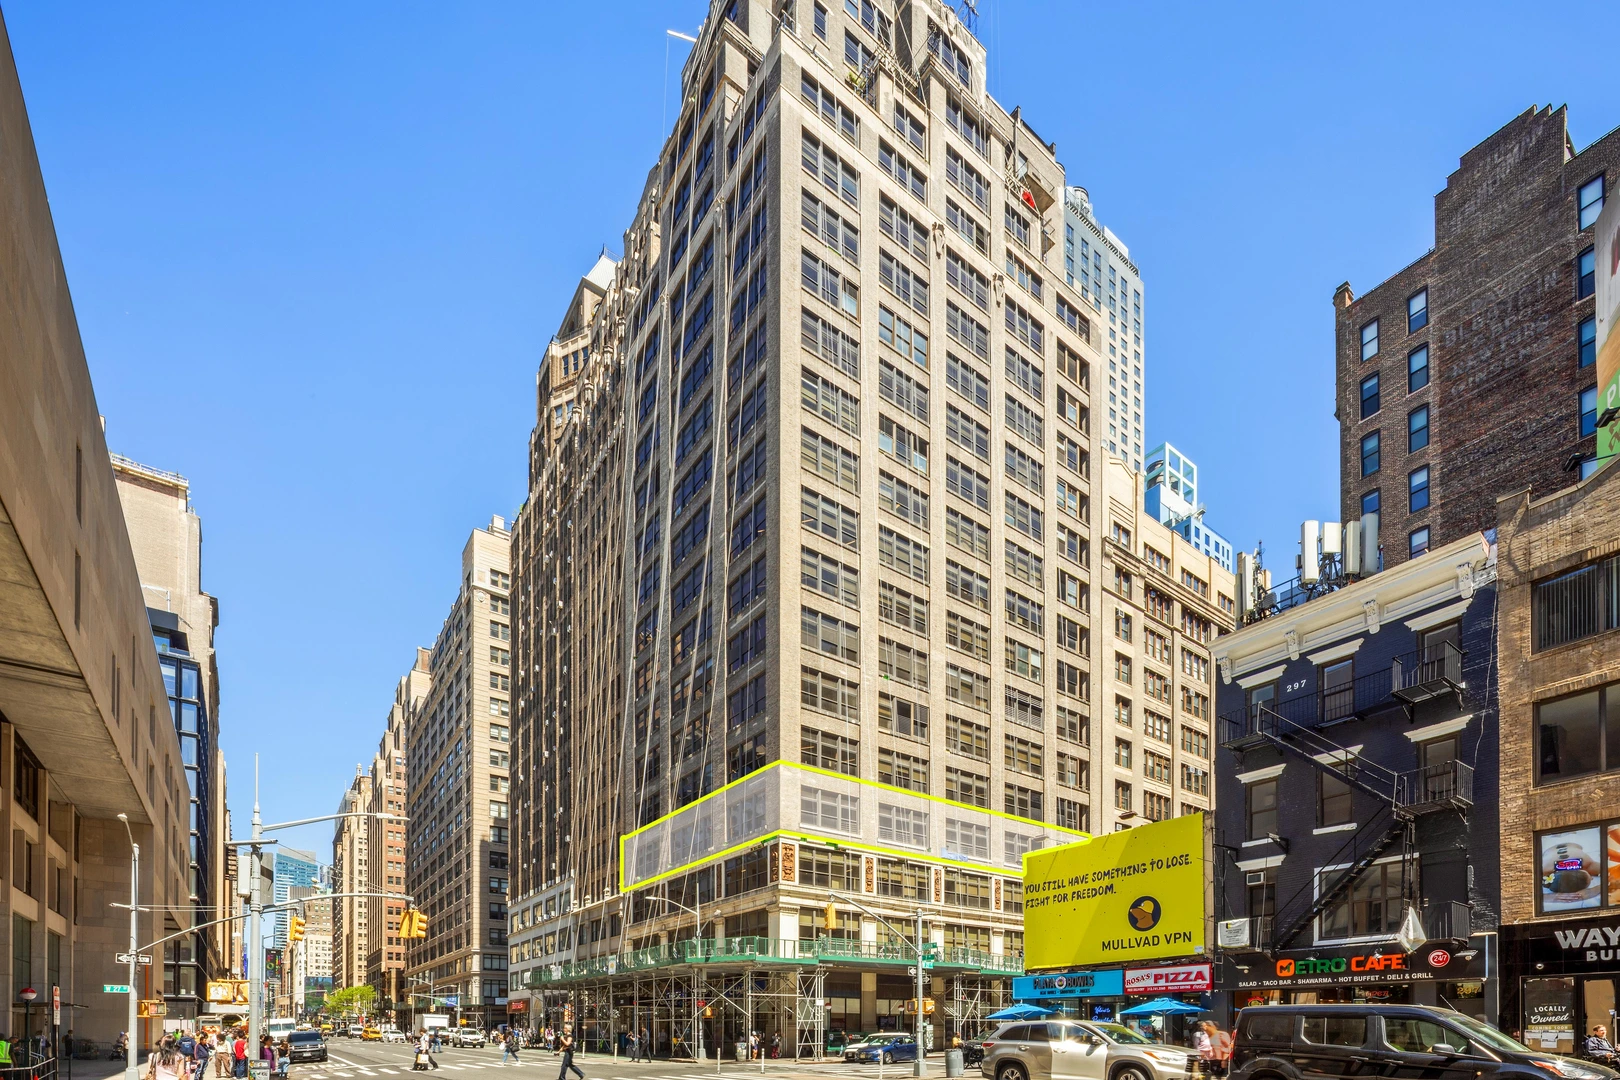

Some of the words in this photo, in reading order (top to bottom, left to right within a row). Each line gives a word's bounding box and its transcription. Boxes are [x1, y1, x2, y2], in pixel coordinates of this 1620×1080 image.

[1286, 680, 1306, 692] 297
[1025, 884, 1040, 894] YOU
[1042, 880, 1066, 892] STILL
[1068, 874, 1089, 886] HAVE
[1092, 863, 1147, 882] SOMETHING
[1150, 858, 1164, 871] TO
[1166, 854, 1192, 869] LOSE.
[1026, 896, 1050, 909] FIGHT
[1053, 893, 1068, 904] FOR
[1072, 884, 1116, 901] FREEDOM.
[1102, 935, 1160, 952] MULLVAD
[1164, 931, 1192, 944] VPN
[1034, 977, 1056, 989] PLAYA
[1066, 975, 1094, 988] BOWLS
[1126, 972, 1151, 986] ROSA'S
[1153, 971, 1206, 984] PIZZA
[1456, 986, 1480, 994] 297
[1531, 1013, 1569, 1024] Owned
